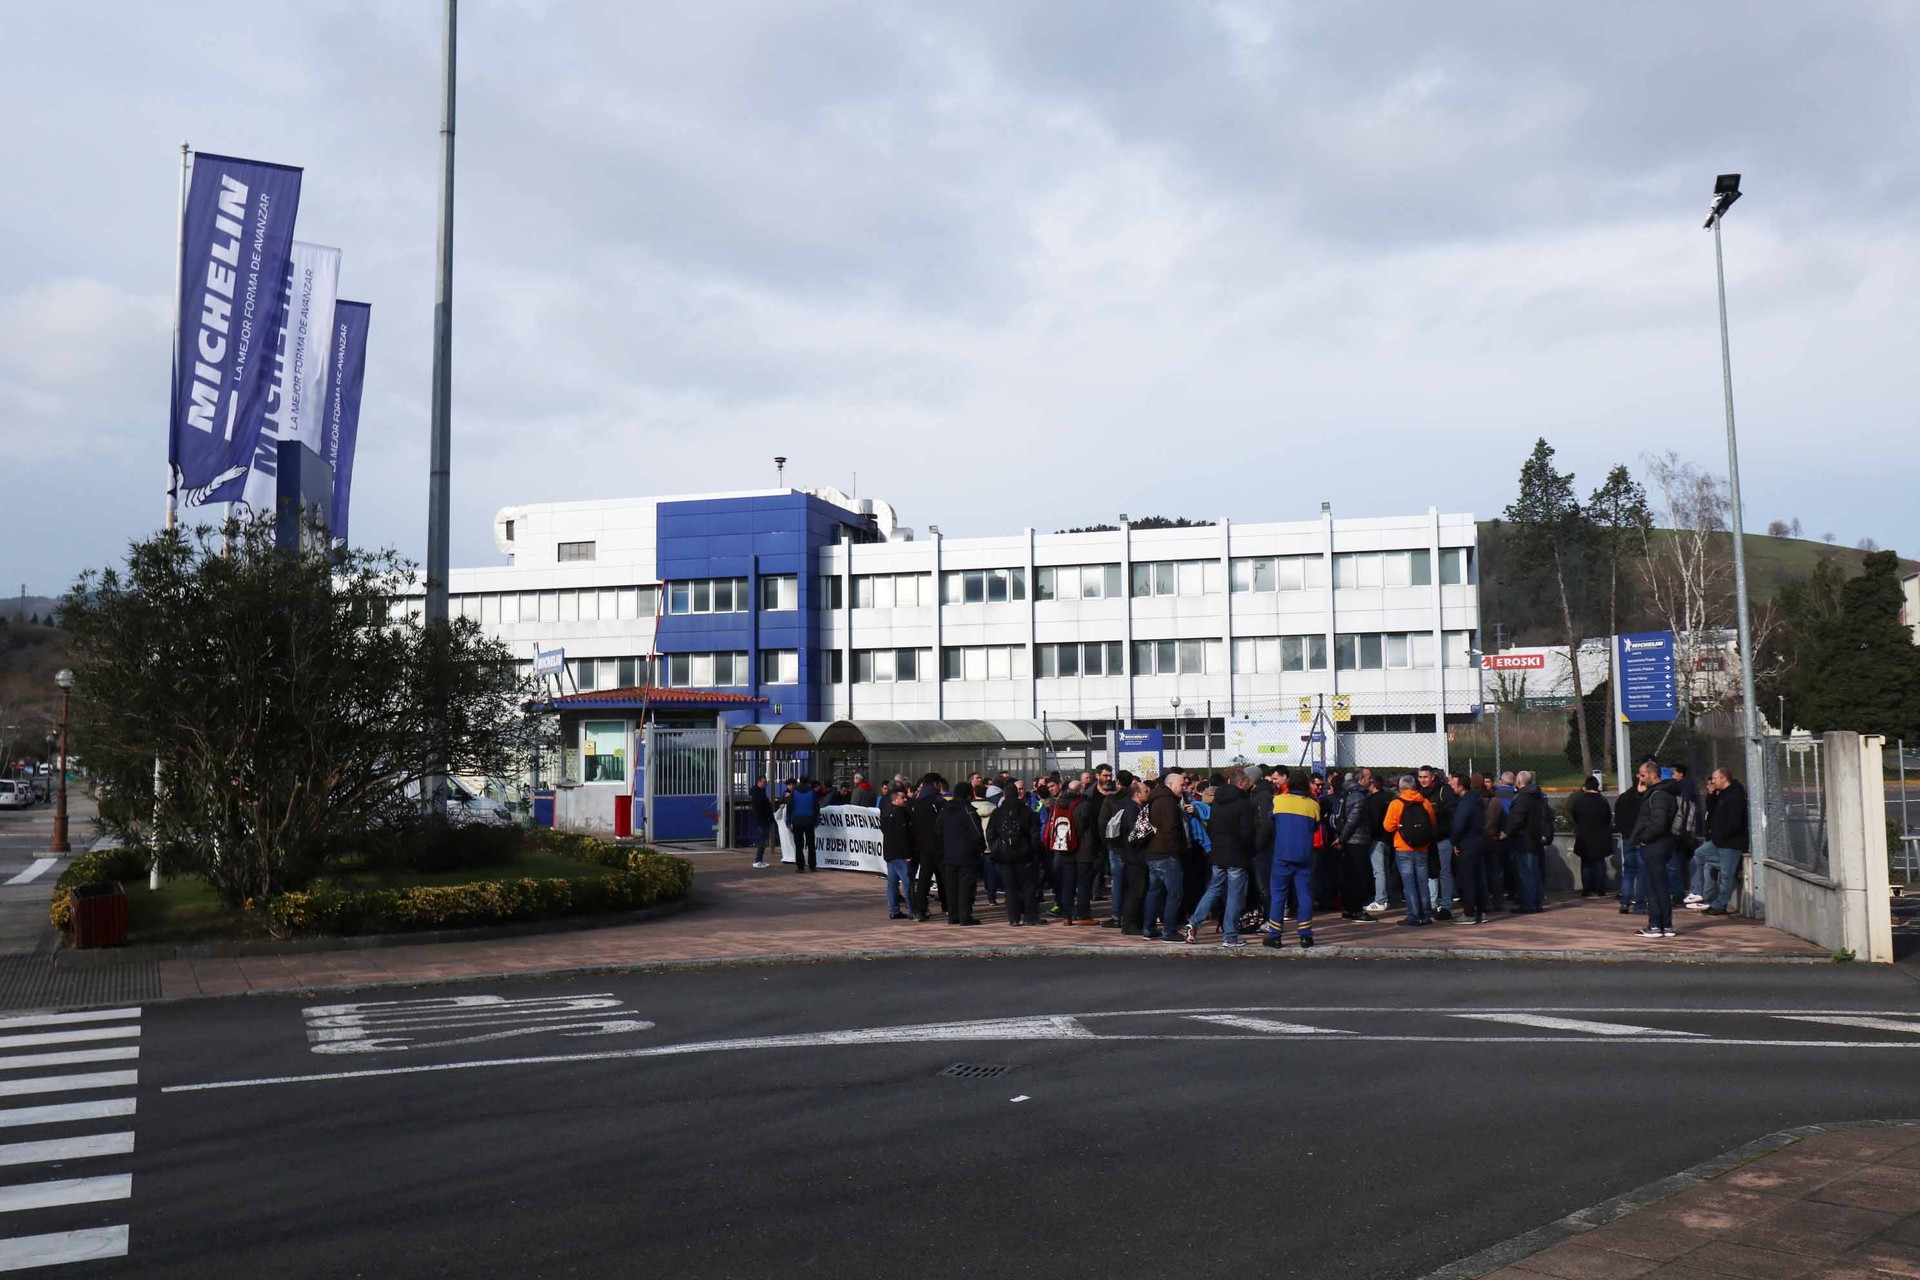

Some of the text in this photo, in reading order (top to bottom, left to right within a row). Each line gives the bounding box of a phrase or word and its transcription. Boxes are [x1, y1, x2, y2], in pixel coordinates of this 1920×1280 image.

[187, 173, 249, 434] MICHELIN
[233, 193, 270, 381] LA MEJOR FORMA DE AVANZAR
[289, 268, 313, 431] LA MEJOR FORMA DE AVANZAR
[337, 323, 348, 371] AVANZAR
[333, 387, 341, 423] FORMA
[330, 423, 340, 458] MEJOR
[1496, 657, 1540, 667] EROSKI
[1631, 641, 1664, 650] MICHELIN
[830, 813, 843, 827] ON
[845, 813, 868, 828] BATEN
[825, 837, 847, 852] BUEN
[849, 839, 882, 856] CONVENIO
